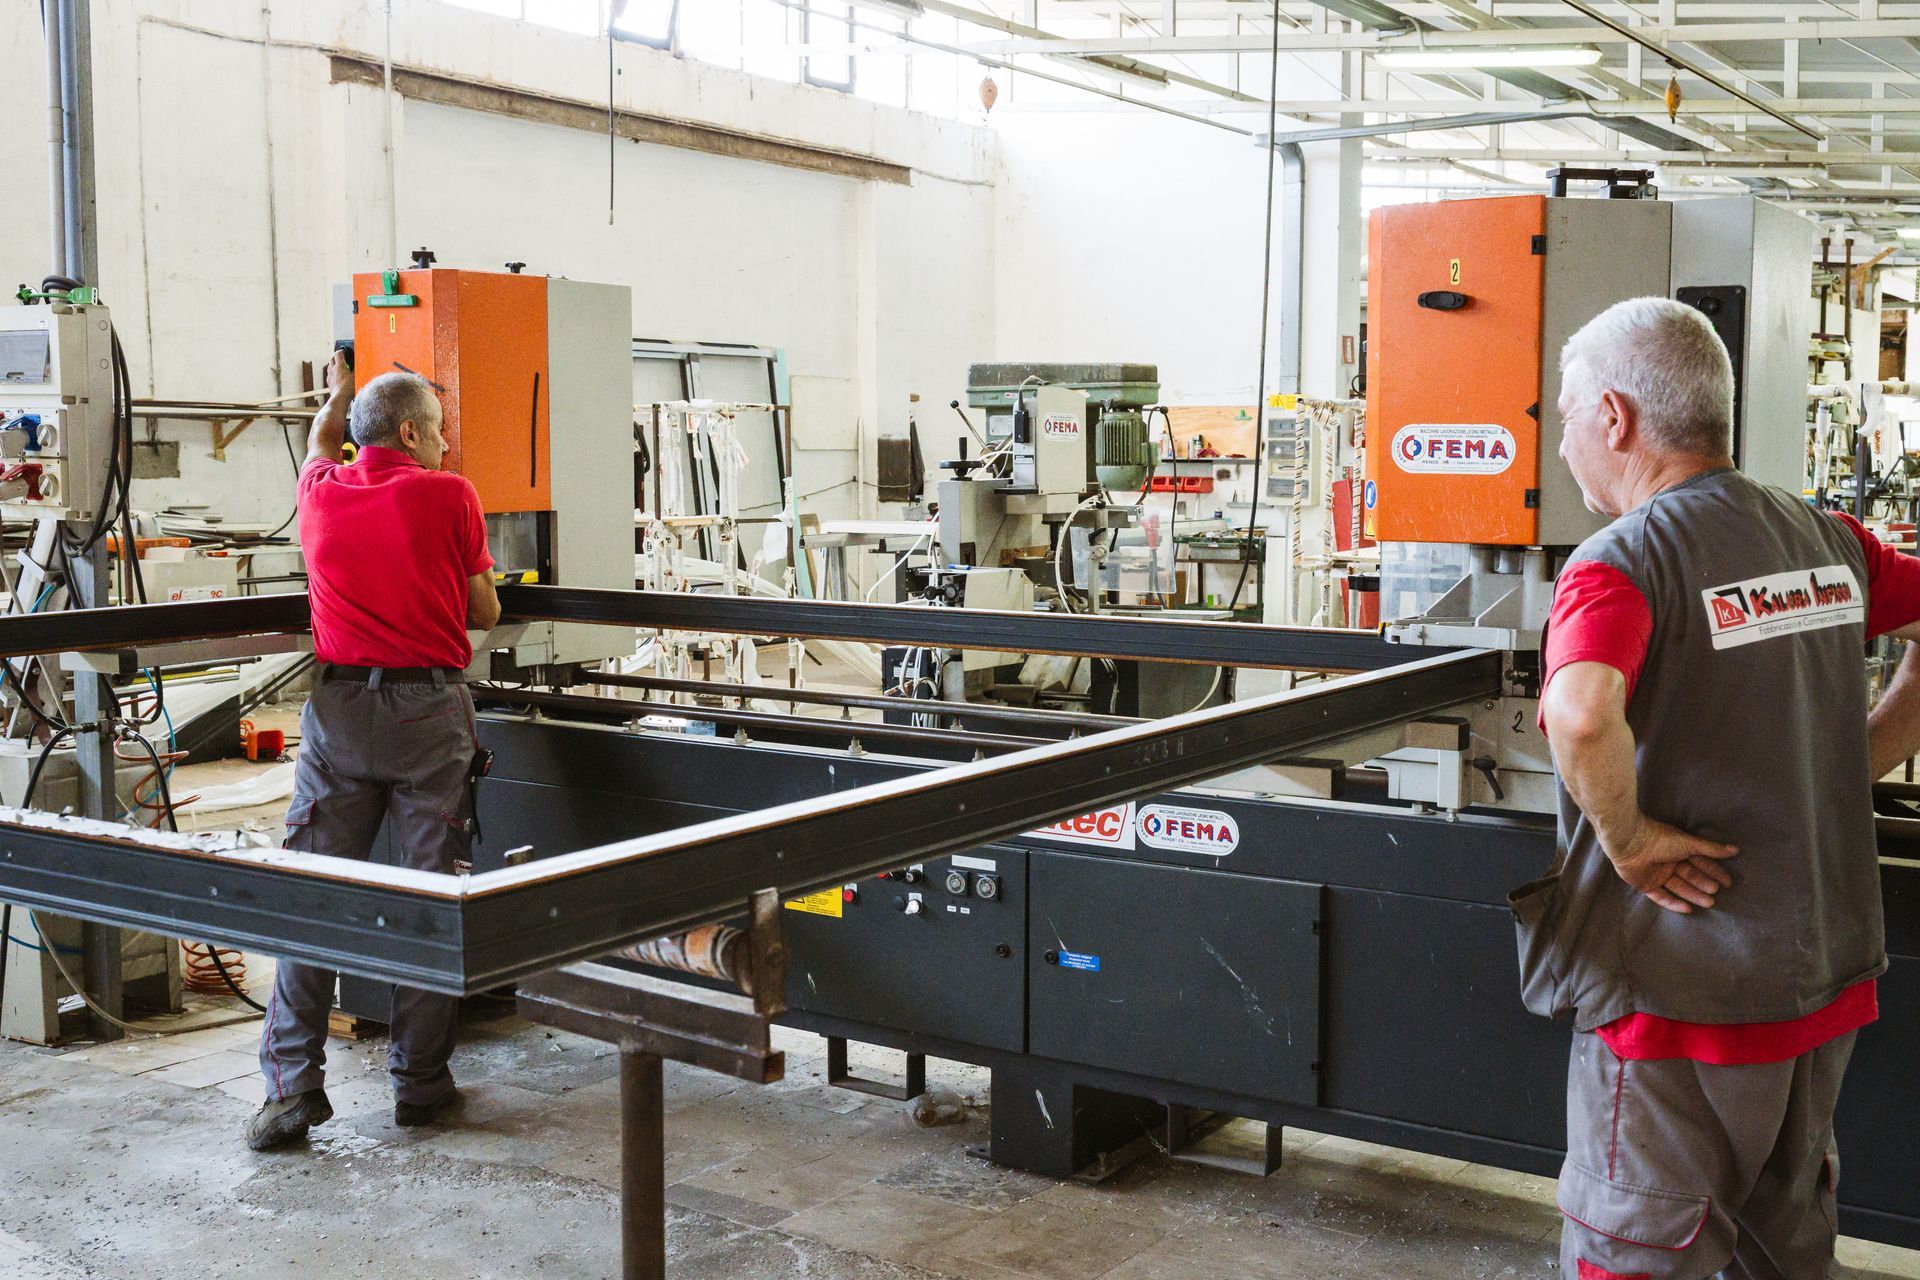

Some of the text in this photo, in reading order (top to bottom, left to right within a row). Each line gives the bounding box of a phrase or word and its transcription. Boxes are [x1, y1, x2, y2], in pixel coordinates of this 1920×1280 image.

[1452, 262, 1459, 282] 2
[1053, 421, 1078, 433] FEMA
[1428, 439, 1509, 459] FEMA
[1511, 711, 1526, 733] 2
[1166, 819, 1233, 843] FEMA
